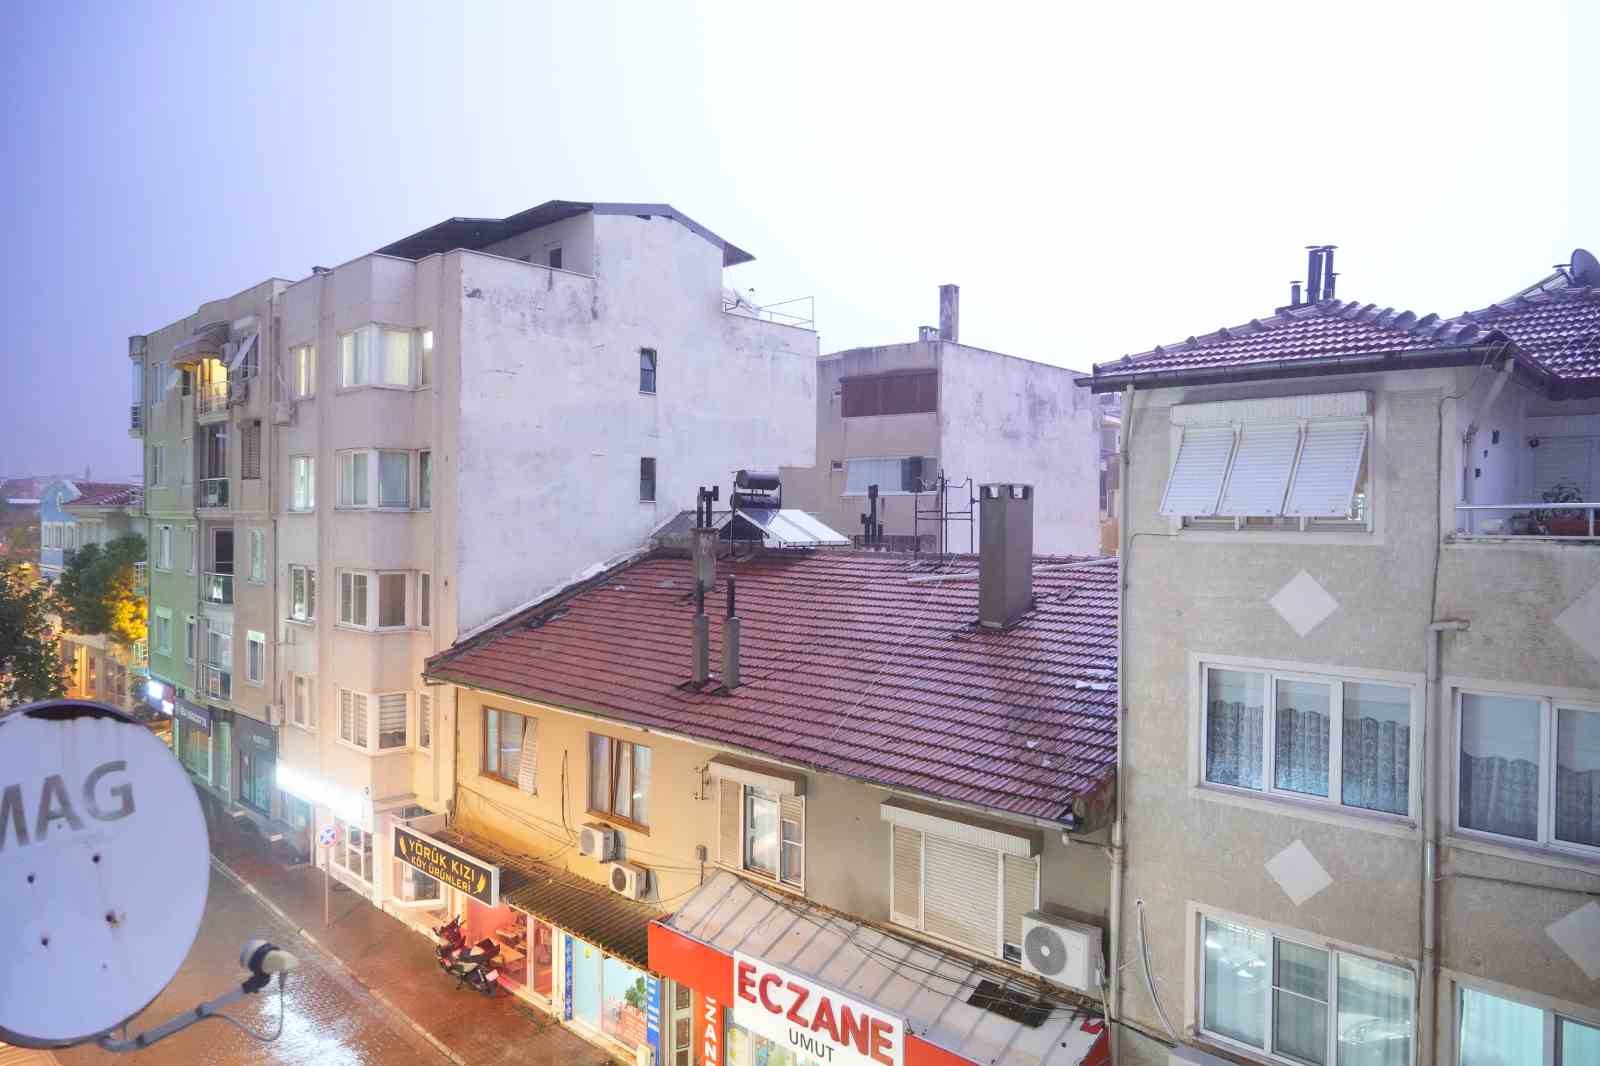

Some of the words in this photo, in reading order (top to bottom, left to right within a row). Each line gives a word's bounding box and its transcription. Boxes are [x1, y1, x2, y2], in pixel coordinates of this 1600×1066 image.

[408, 839, 448, 869] YÖRÜK
[451, 859, 475, 883] KIZI
[411, 855, 427, 868] KÖY
[704, 995, 718, 1066] ZAN
[738, 960, 894, 1066] ECZANE
[788, 1027, 835, 1063] UMUT
